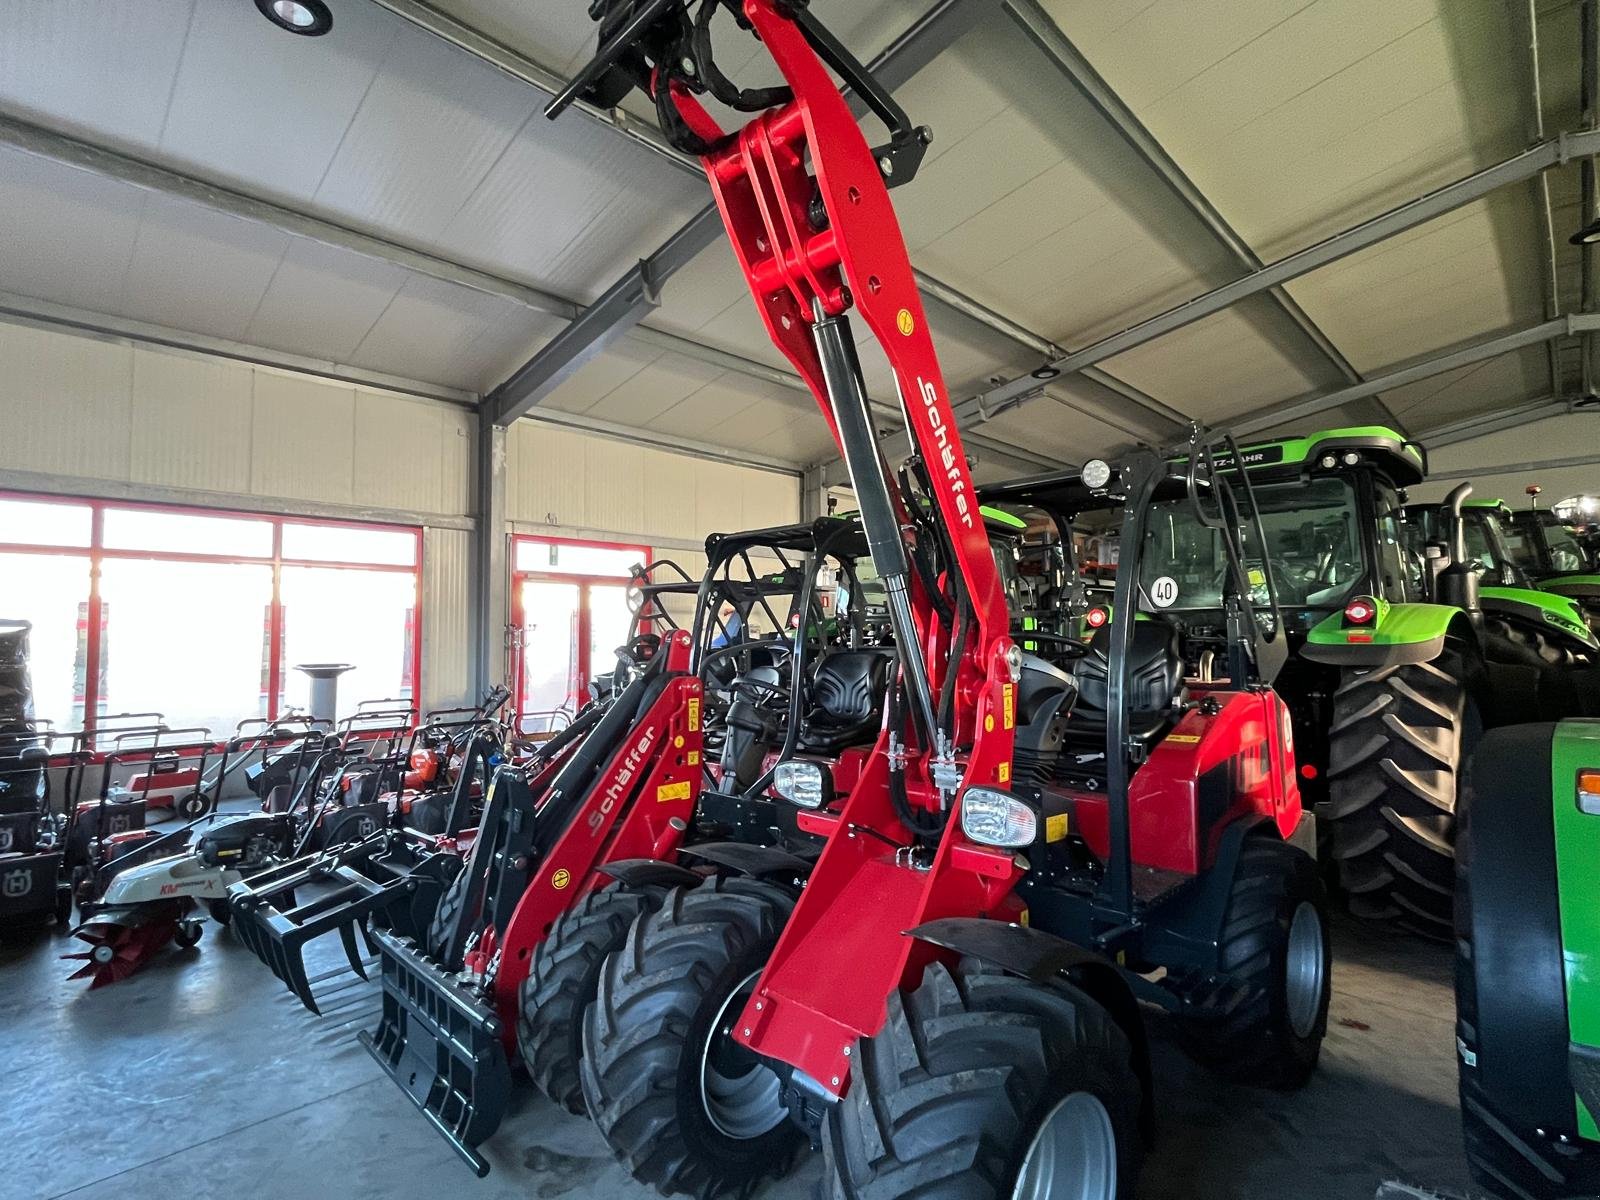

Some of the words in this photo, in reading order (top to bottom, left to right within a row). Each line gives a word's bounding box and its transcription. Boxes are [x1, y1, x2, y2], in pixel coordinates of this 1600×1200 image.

[917, 376, 973, 529] Schäffer
[1157, 582, 1172, 600] 40
[588, 726, 655, 837] Schäffer
